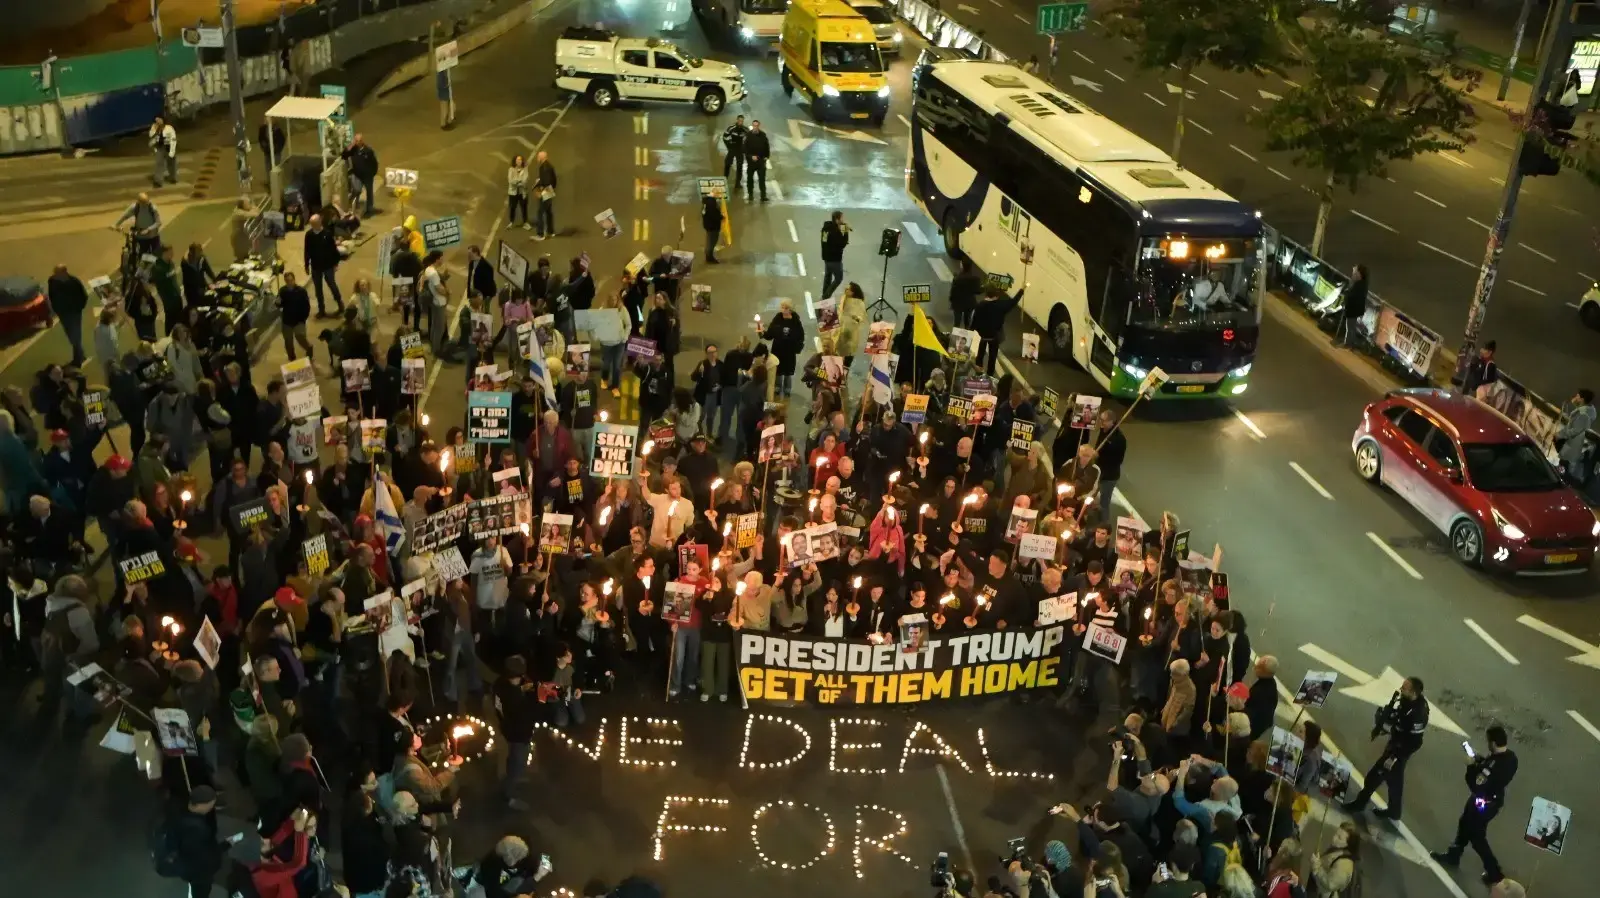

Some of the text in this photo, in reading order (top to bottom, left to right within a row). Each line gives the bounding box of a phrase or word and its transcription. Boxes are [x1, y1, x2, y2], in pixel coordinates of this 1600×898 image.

[472, 407, 508, 417] כמה דם
[481, 418, 499, 428] עוד
[597, 432, 632, 448] SEAL
[600, 446, 627, 461] THE
[594, 459, 629, 475] DEAL
[741, 625, 1064, 671] PRESIDENT TRUMP
[740, 667, 848, 701] GET ALL
[818, 656, 1061, 704] OF THEM HOME
[738, 712, 1056, 780] DEAL
[652, 795, 922, 880] FOR
